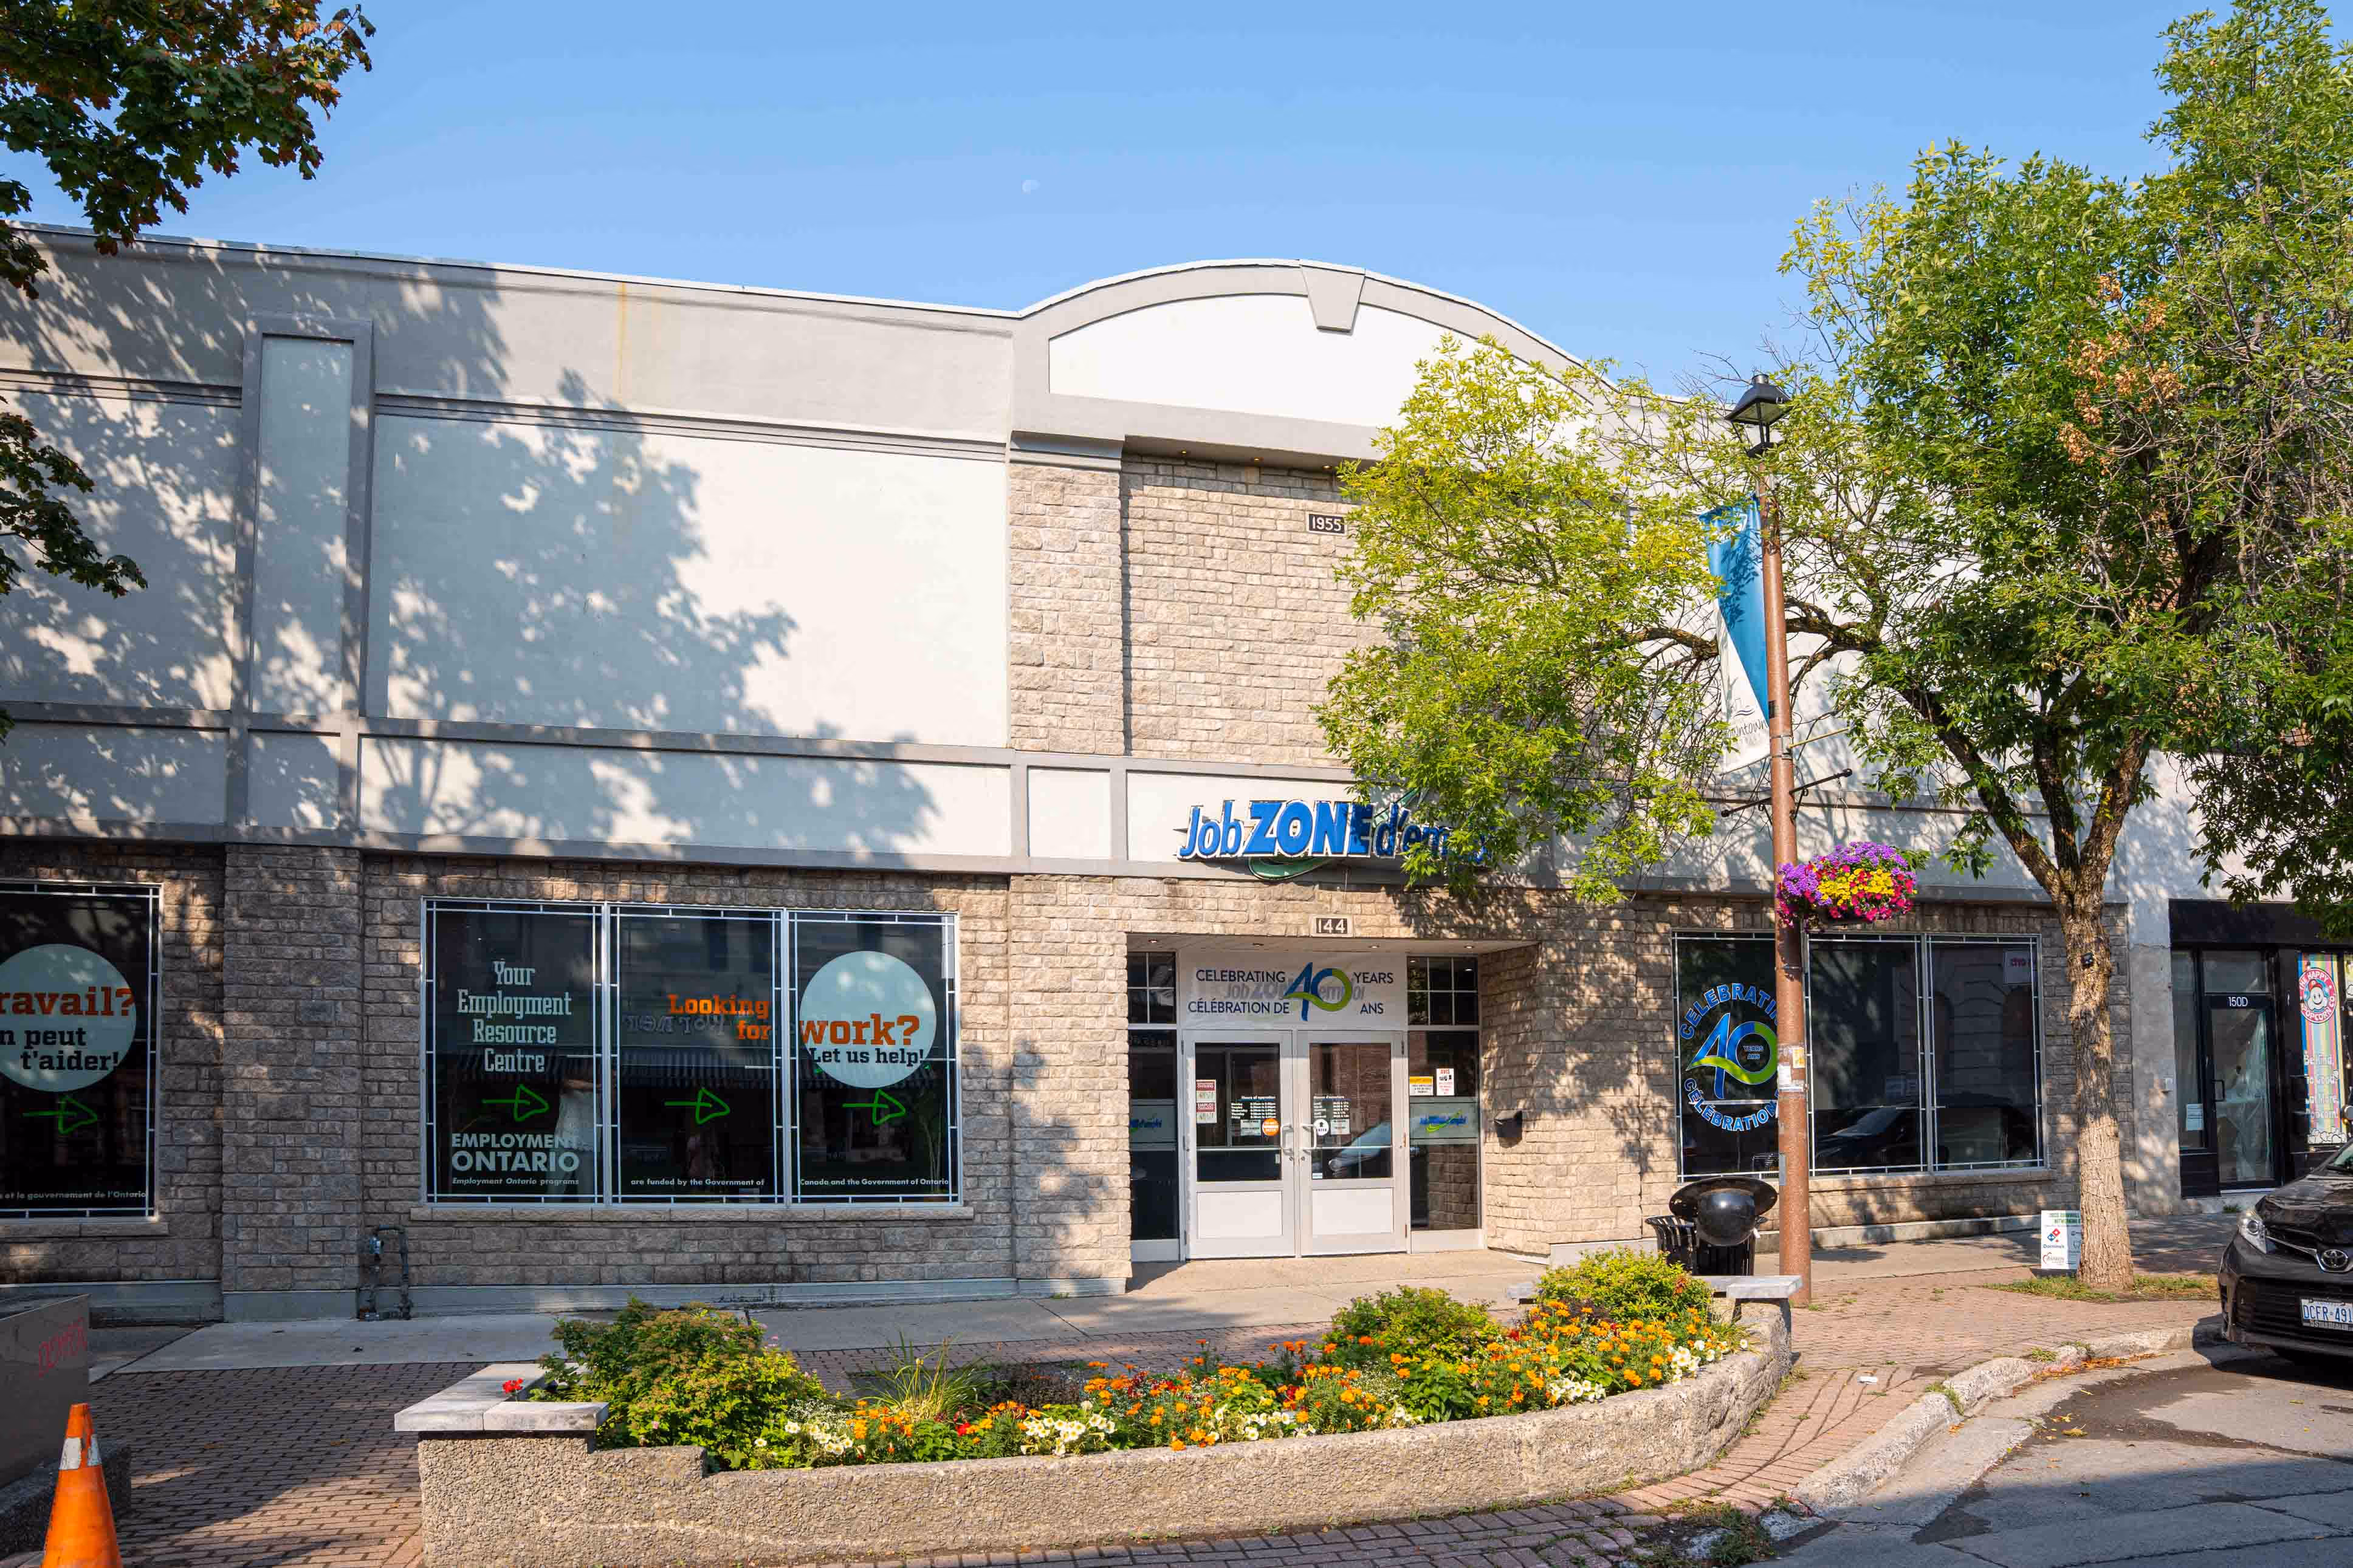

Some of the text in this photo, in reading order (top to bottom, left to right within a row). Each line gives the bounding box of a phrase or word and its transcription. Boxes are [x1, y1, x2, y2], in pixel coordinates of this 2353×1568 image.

[1311, 515, 1342, 532] 1955
[1317, 918, 1345, 934] 144
[493, 960, 535, 985] Your
[2307, 971, 2329, 982] HAPPY
[1195, 969, 1285, 983] CELEBRATING
[1283, 962, 1352, 1021] 40
[1353, 971, 1393, 984] YEARS
[2228, 996, 2248, 1007] 150D
[457, 988, 572, 1019] Employment
[667, 994, 769, 1020] Looking
[1187, 998, 1384, 1015] CÉLÉBRATION DE ANS
[1679, 983, 1778, 1039] CELEBRATI
[24, 1027, 86, 1050] peut
[472, 1018, 557, 1044] Resource
[735, 1020, 772, 1040] for
[799, 1013, 919, 1046] work?
[20, 1050, 119, 1070] t'aider!
[484, 1047, 545, 1073] Centre
[809, 1047, 924, 1067] Let us help!
[1685, 1012, 1778, 1100] 40
[1684, 1078, 1778, 1132] CÉLÉBRATION
[452, 1150, 579, 1172] ONTARIO
[452, 1177, 503, 1186] Employment
[677, 1178, 687, 1186] by
[27, 1191, 92, 1200] gouvernement
[94, 1190, 106, 1199] de
